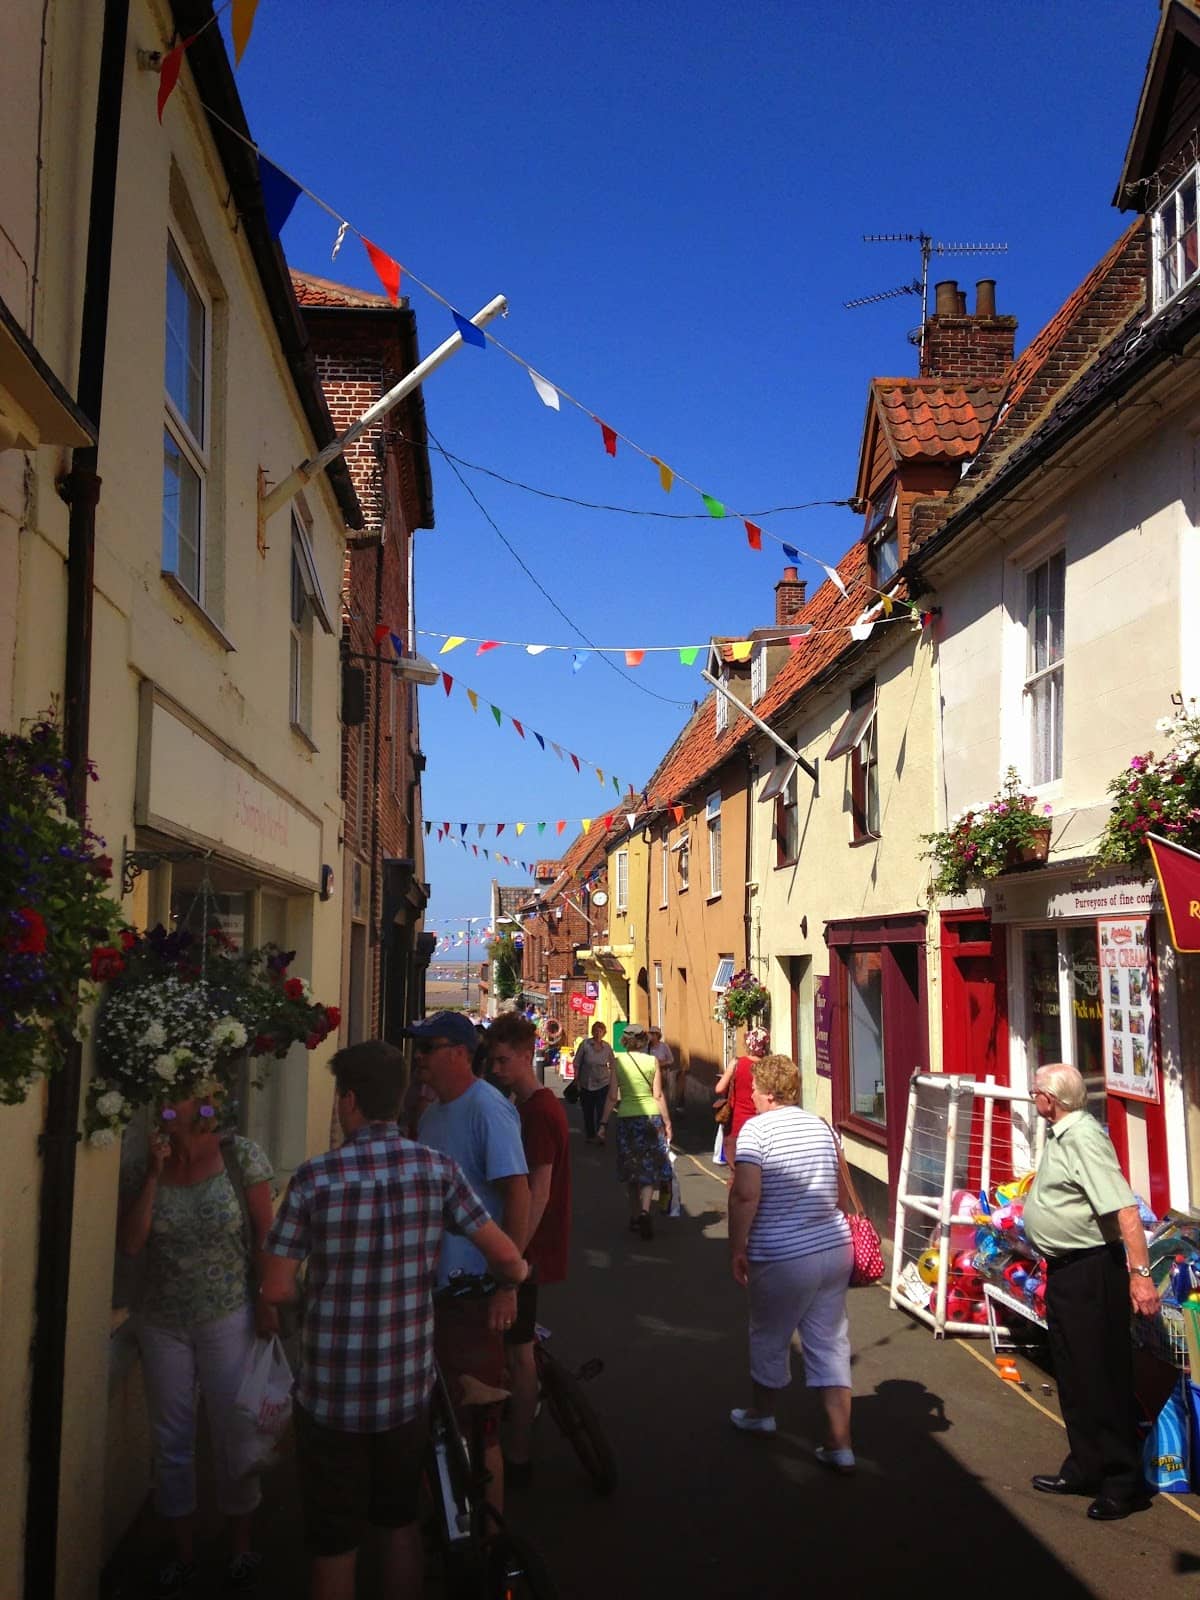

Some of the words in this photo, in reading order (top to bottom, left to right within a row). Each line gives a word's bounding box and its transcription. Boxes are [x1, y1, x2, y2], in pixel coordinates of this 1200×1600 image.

[1075, 897, 1108, 910] Purveyors
[1109, 894, 1118, 906] of
[1119, 893, 1134, 905] fine
[1101, 948, 1116, 968] ICE
